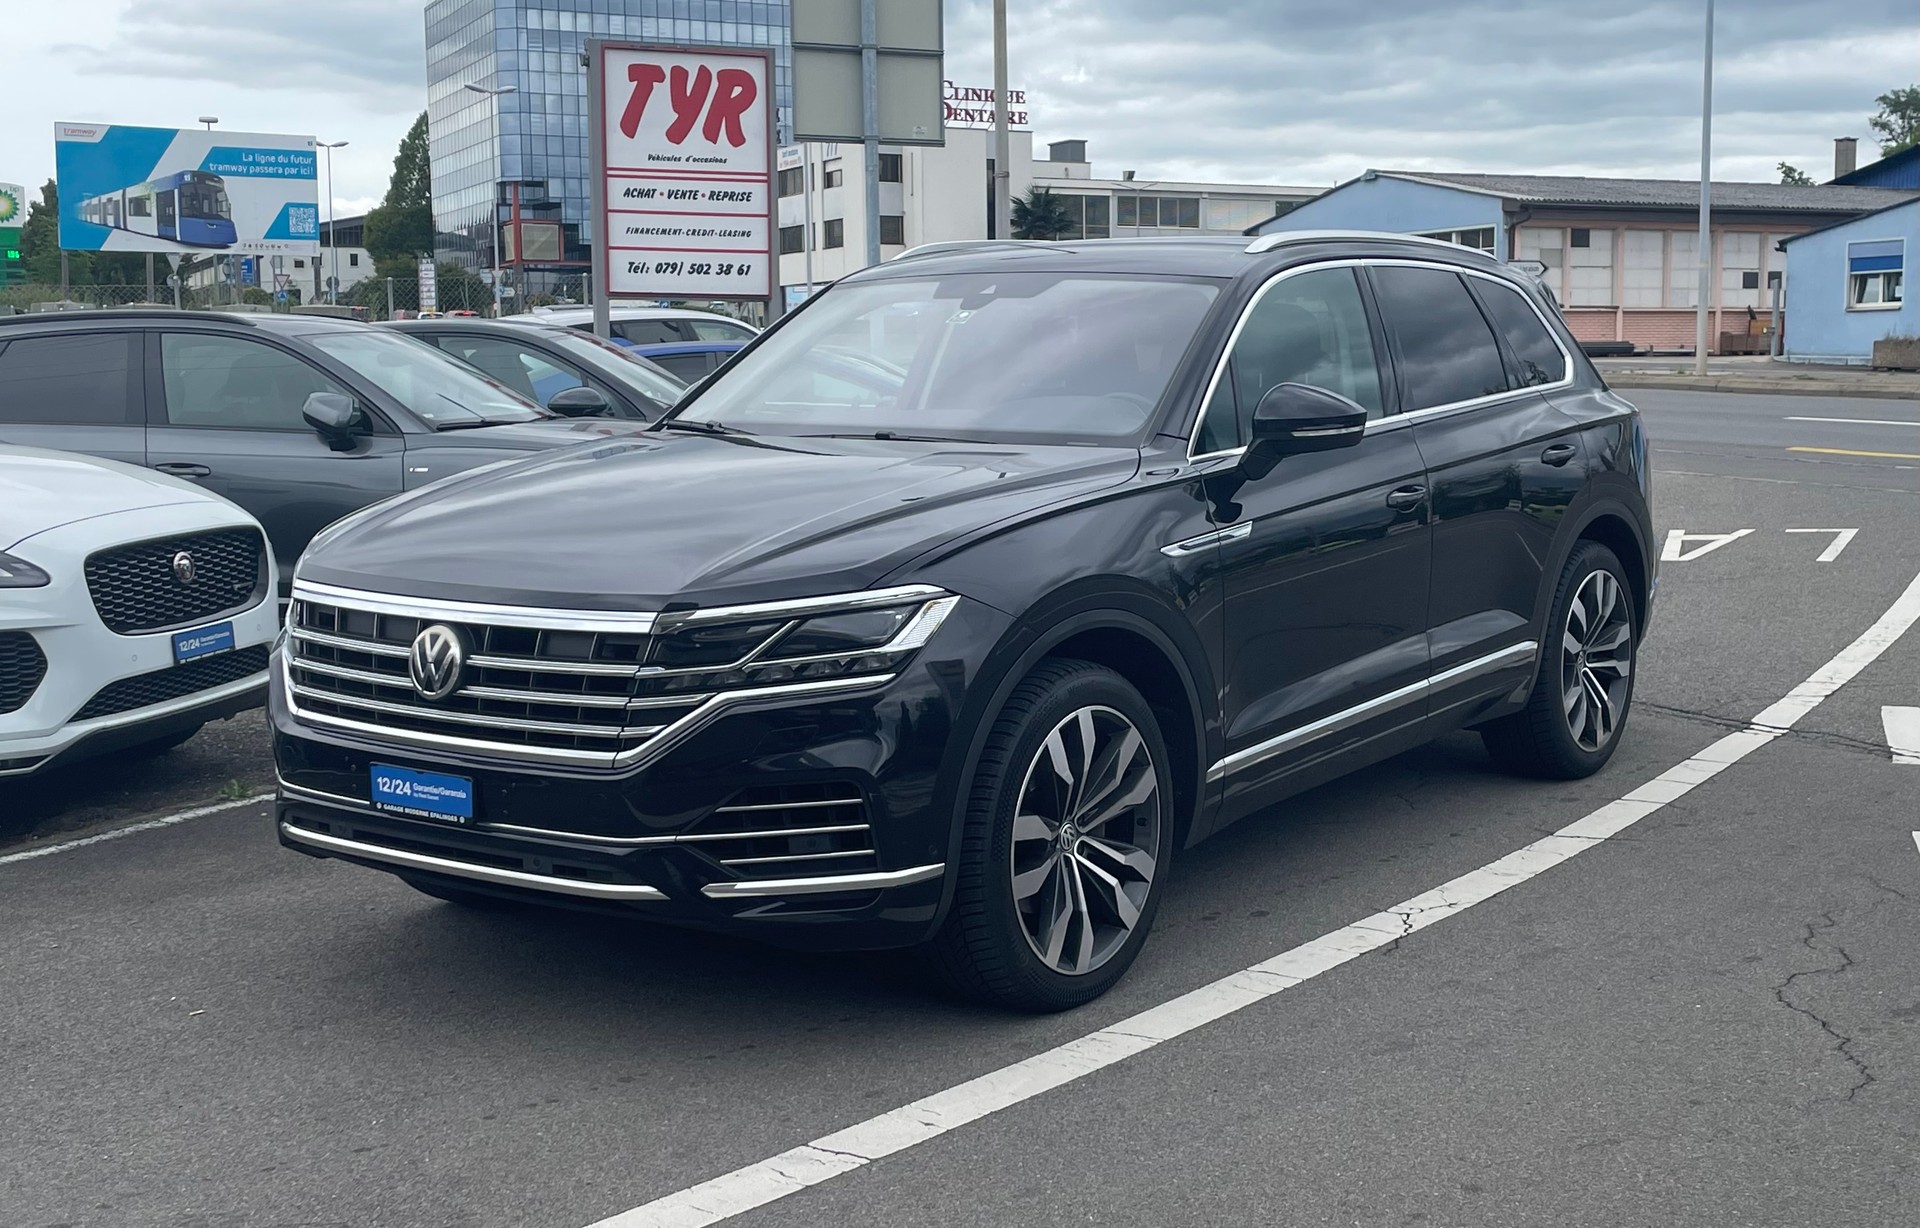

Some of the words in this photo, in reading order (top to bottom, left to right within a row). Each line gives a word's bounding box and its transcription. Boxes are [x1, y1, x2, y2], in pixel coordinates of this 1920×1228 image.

[619, 63, 757, 148] TYR
[943, 101, 1029, 125] DENTARE
[242, 152, 253, 162] La
[255, 153, 276, 164] ligne
[277, 154, 288, 163] du
[290, 154, 312, 164] futur
[647, 153, 682, 162] Véhicules
[685, 155, 728, 164] d'occasions
[209, 163, 247, 173] tramway
[249, 165, 282, 174] passera
[284, 167, 298, 175] par
[623, 187, 657, 199] ACHAT
[667, 188, 699, 200] VENTE
[708, 190, 752, 202] REPRISE
[627, 261, 650, 274] Tél:
[687, 263, 712, 275] 502
[715, 263, 734, 276] 38
[737, 264, 752, 276] 61
[179, 638, 200, 652] 12/24
[377, 776, 412, 796] 12/24
